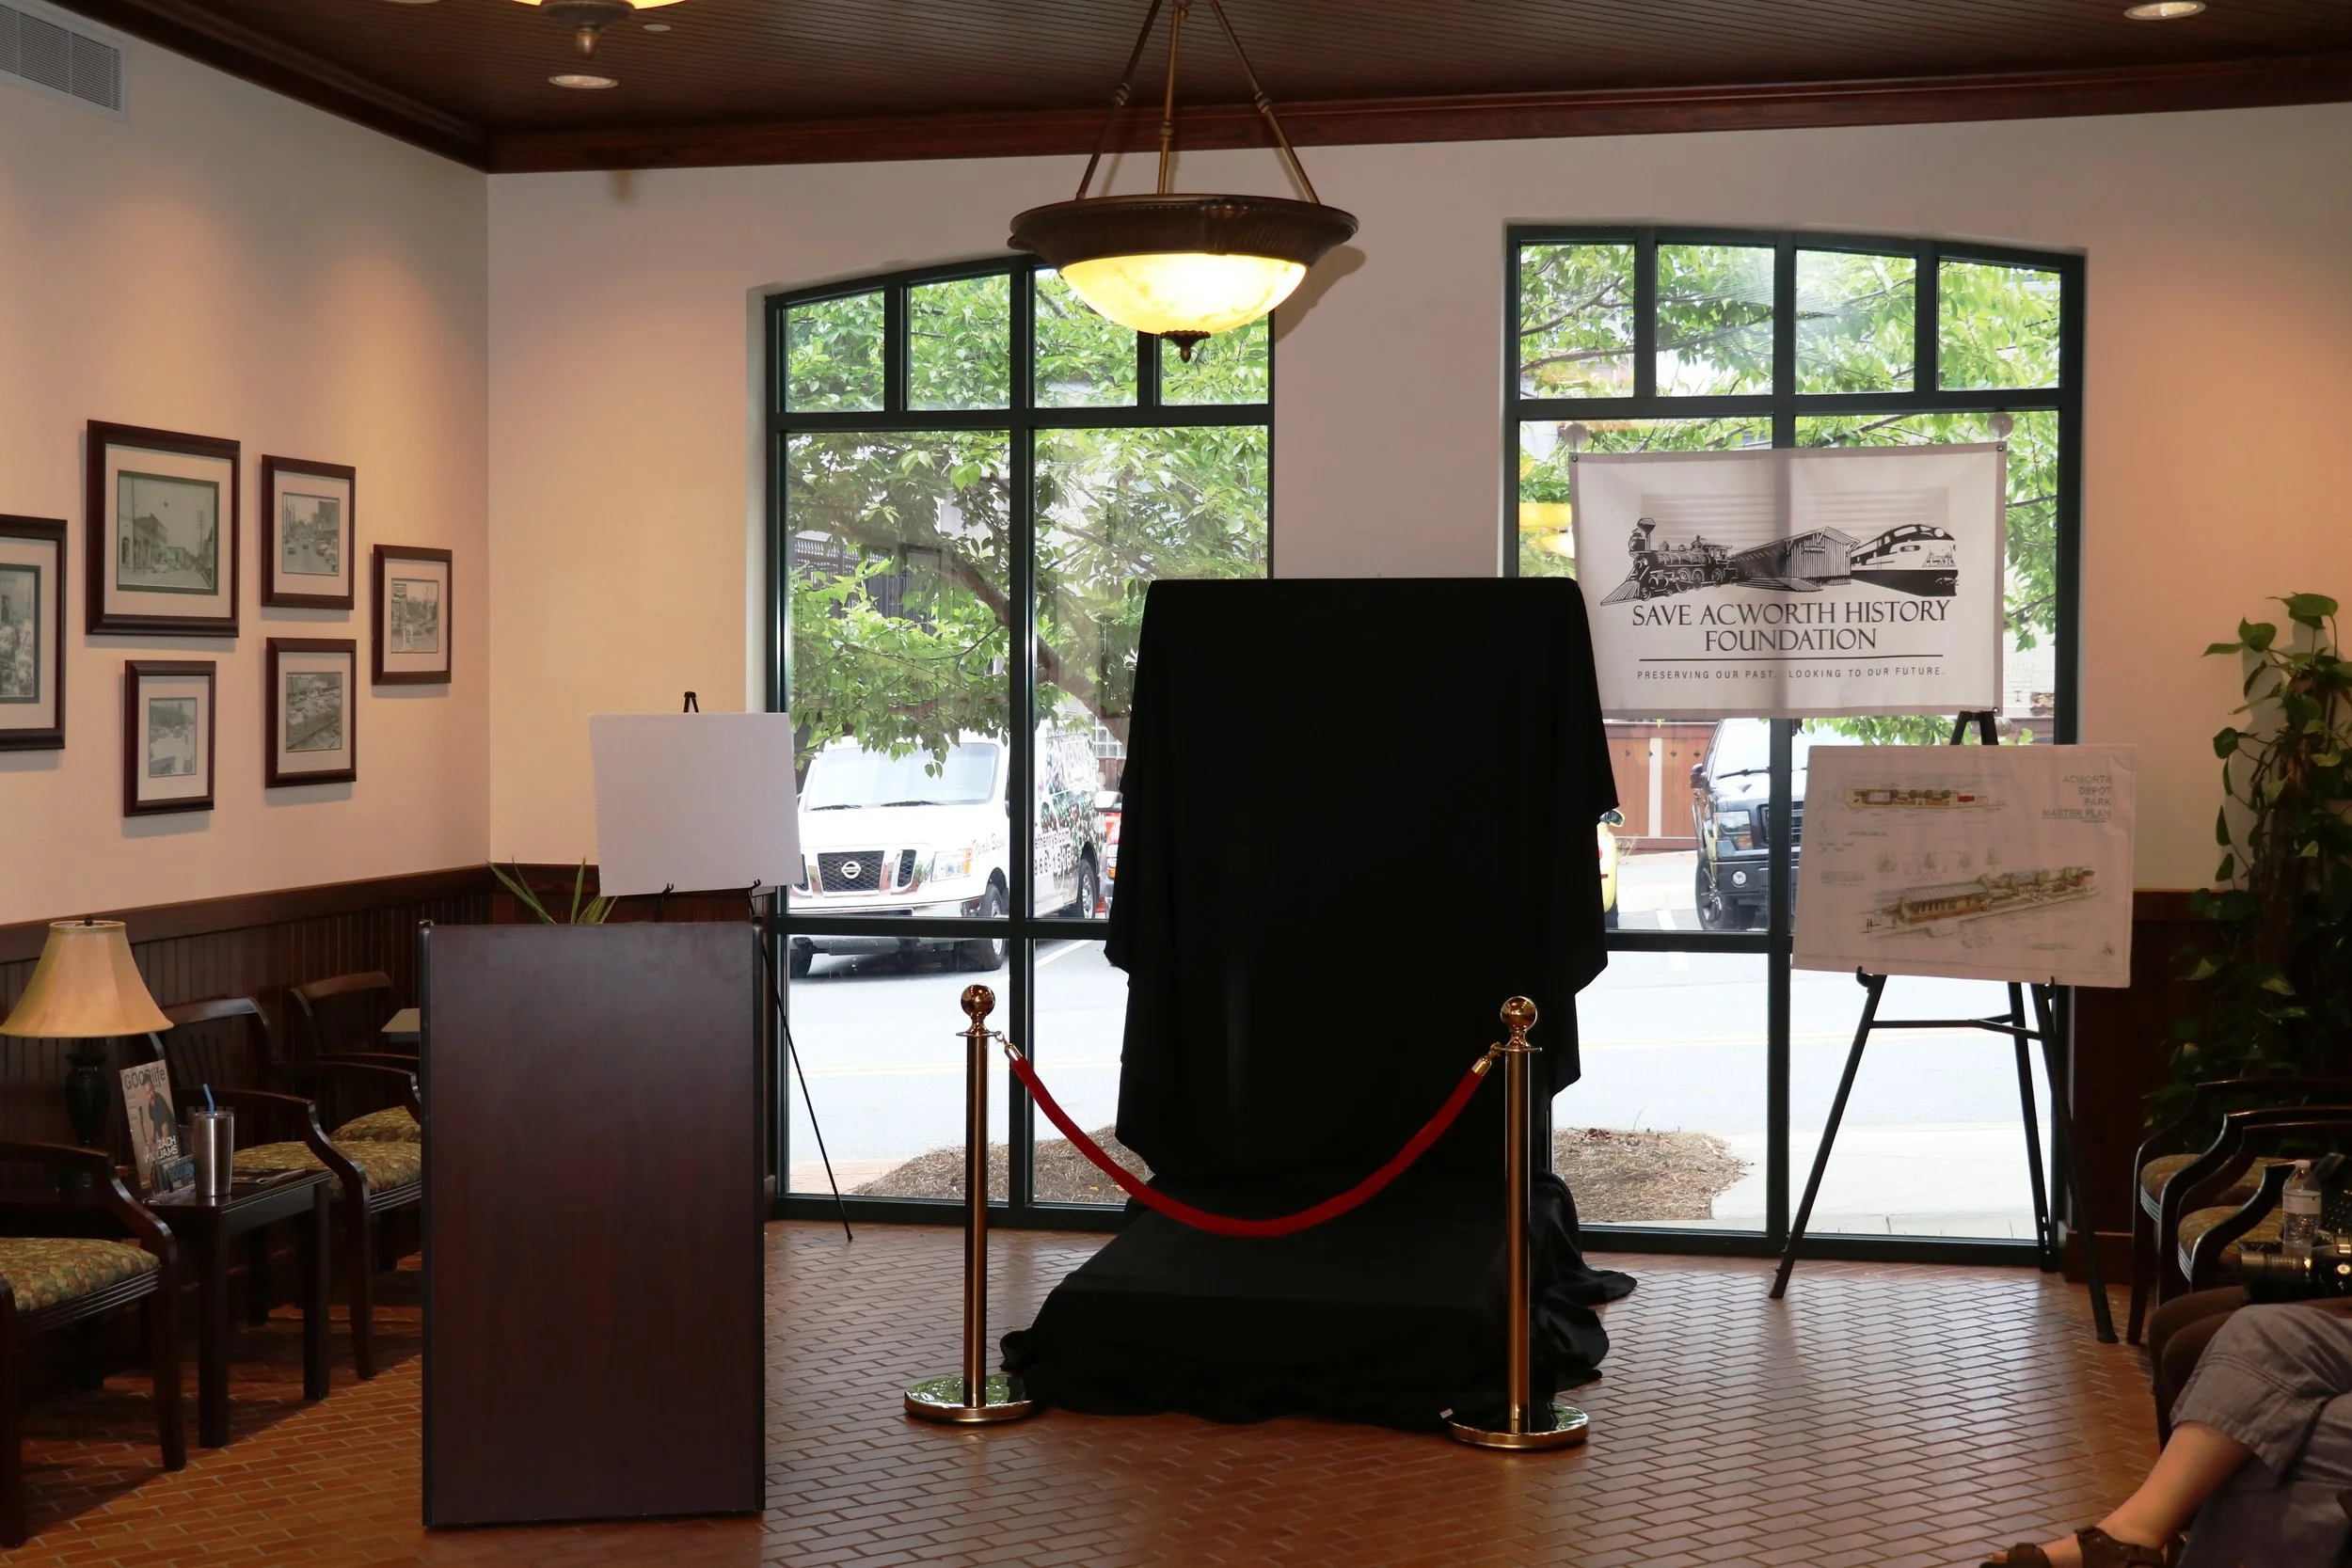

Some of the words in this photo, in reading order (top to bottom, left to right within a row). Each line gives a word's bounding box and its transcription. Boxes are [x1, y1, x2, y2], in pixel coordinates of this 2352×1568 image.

[1632, 603, 1692, 626] SAVE
[1699, 602, 1836, 626] ACWORTH
[1845, 600, 1951, 624] HISTORY
[1705, 628, 1878, 652] FOUNDATION
[1637, 671, 1709, 679] PRESERVING
[1715, 670, 1739, 679] OUR
[1745, 670, 1777, 679] PAST.
[1788, 669, 1841, 678] LOOKING
[1848, 669, 1862, 677] TO
[1867, 667, 1889, 676] OUR
[1895, 666, 1946, 675] FUTURE.
[2062, 775, 2112, 784] ACWORTH
[2079, 785, 2112, 795] DEPOT
[2085, 798, 2111, 806] PARK
[2042, 809, 2083, 818] MASTER
[2086, 809, 2111, 818] PLAN
[157, 1134, 177, 1148] ZACH
